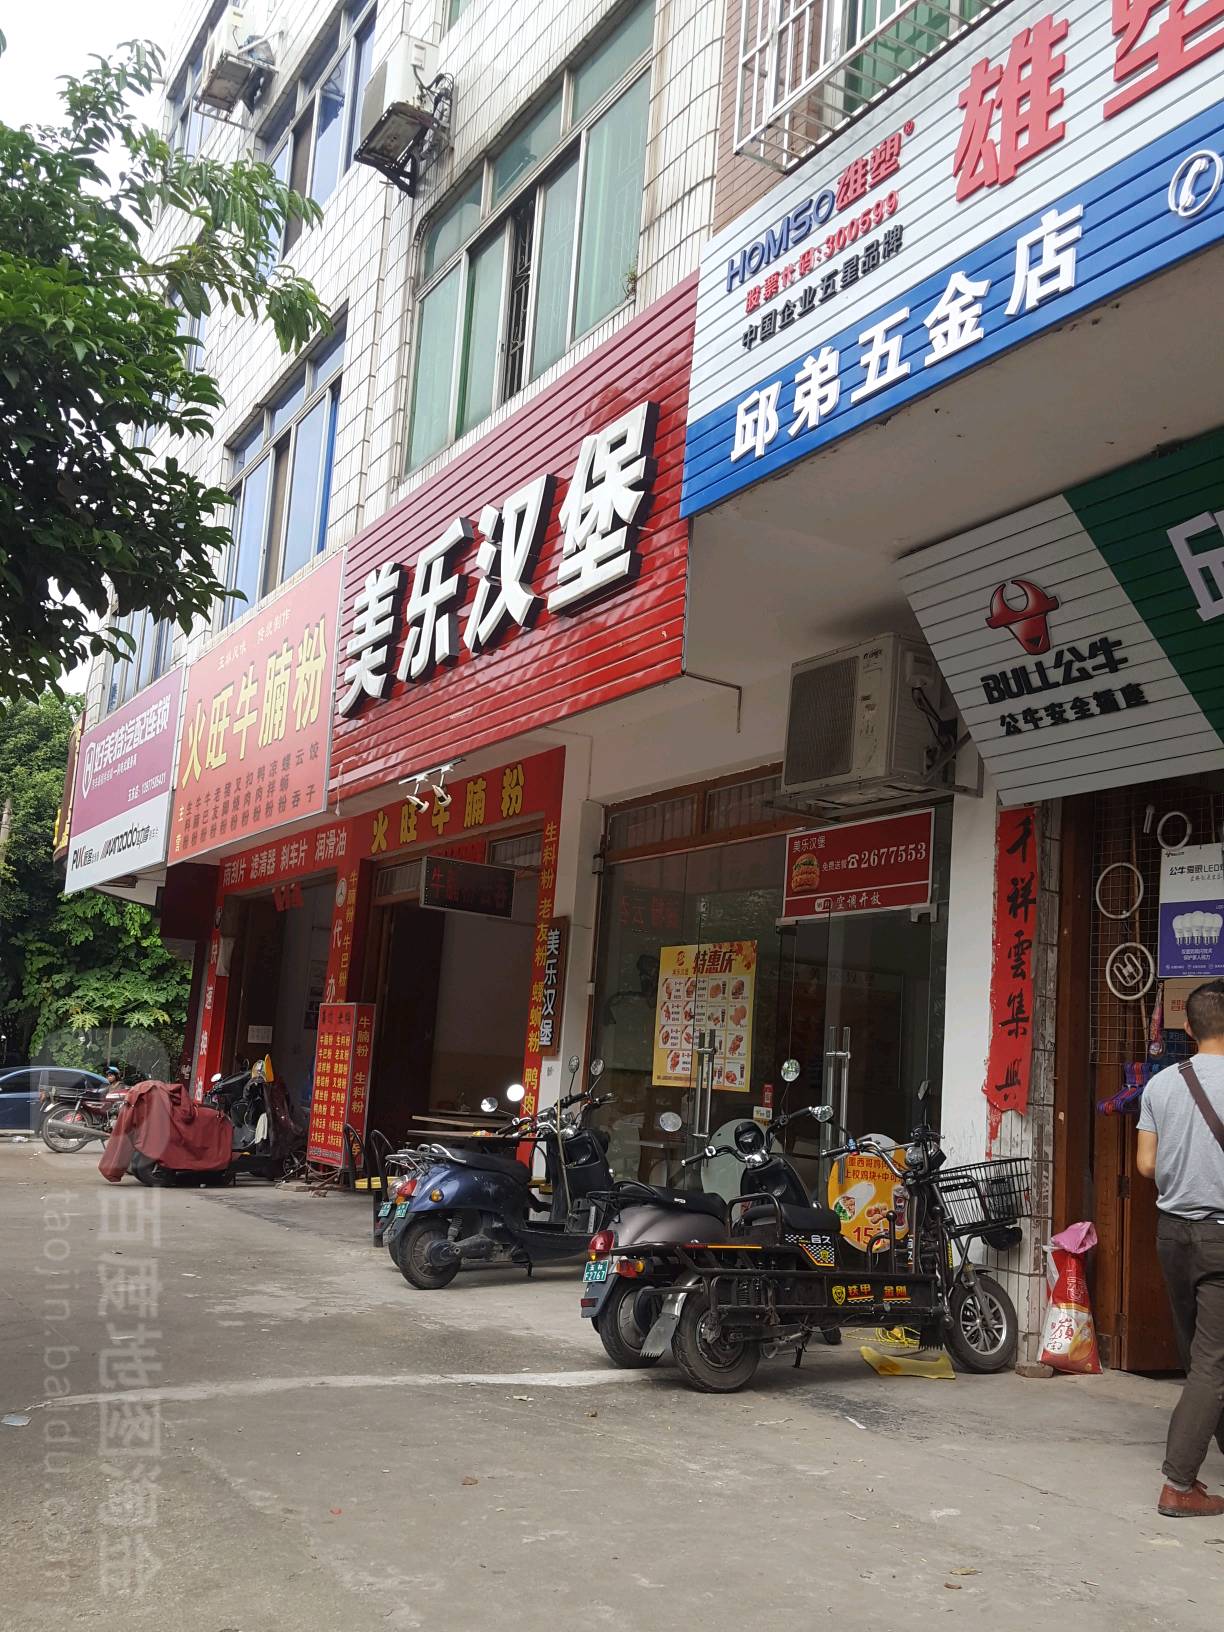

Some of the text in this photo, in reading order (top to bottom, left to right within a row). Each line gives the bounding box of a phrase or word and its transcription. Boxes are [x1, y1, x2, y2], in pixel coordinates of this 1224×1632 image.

[741, 224, 904, 350] 中国企业五星品牌
[730, 203, 1085, 463] 邱弟五金店
[338, 400, 659, 718] 美乐汉堡
[181, 615, 328, 790] 火旺牛腩粉
[980, 636, 1129, 704] BULL公牛
[371, 764, 525, 854] 火旺牛腩粉
[222, 827, 347, 888] 雨刮片 滤清器 刹车片 润滑油
[539, 822, 558, 890] 生料粉
[792, 834, 827, 853] 美乐汉堡
[861, 842, 927, 868] 2677553
[534, 896, 553, 968] 老友粉
[836, 891, 882, 910] 空调开放
[538, 927, 561, 1048] 美乐汉堡
[355, 1015, 371, 1057] 牛腩粉
[351, 1071, 367, 1114] 生料粉
[585, 1270, 606, 1281] F2767
[847, 1284, 908, 1298] 铁甲 金刚
